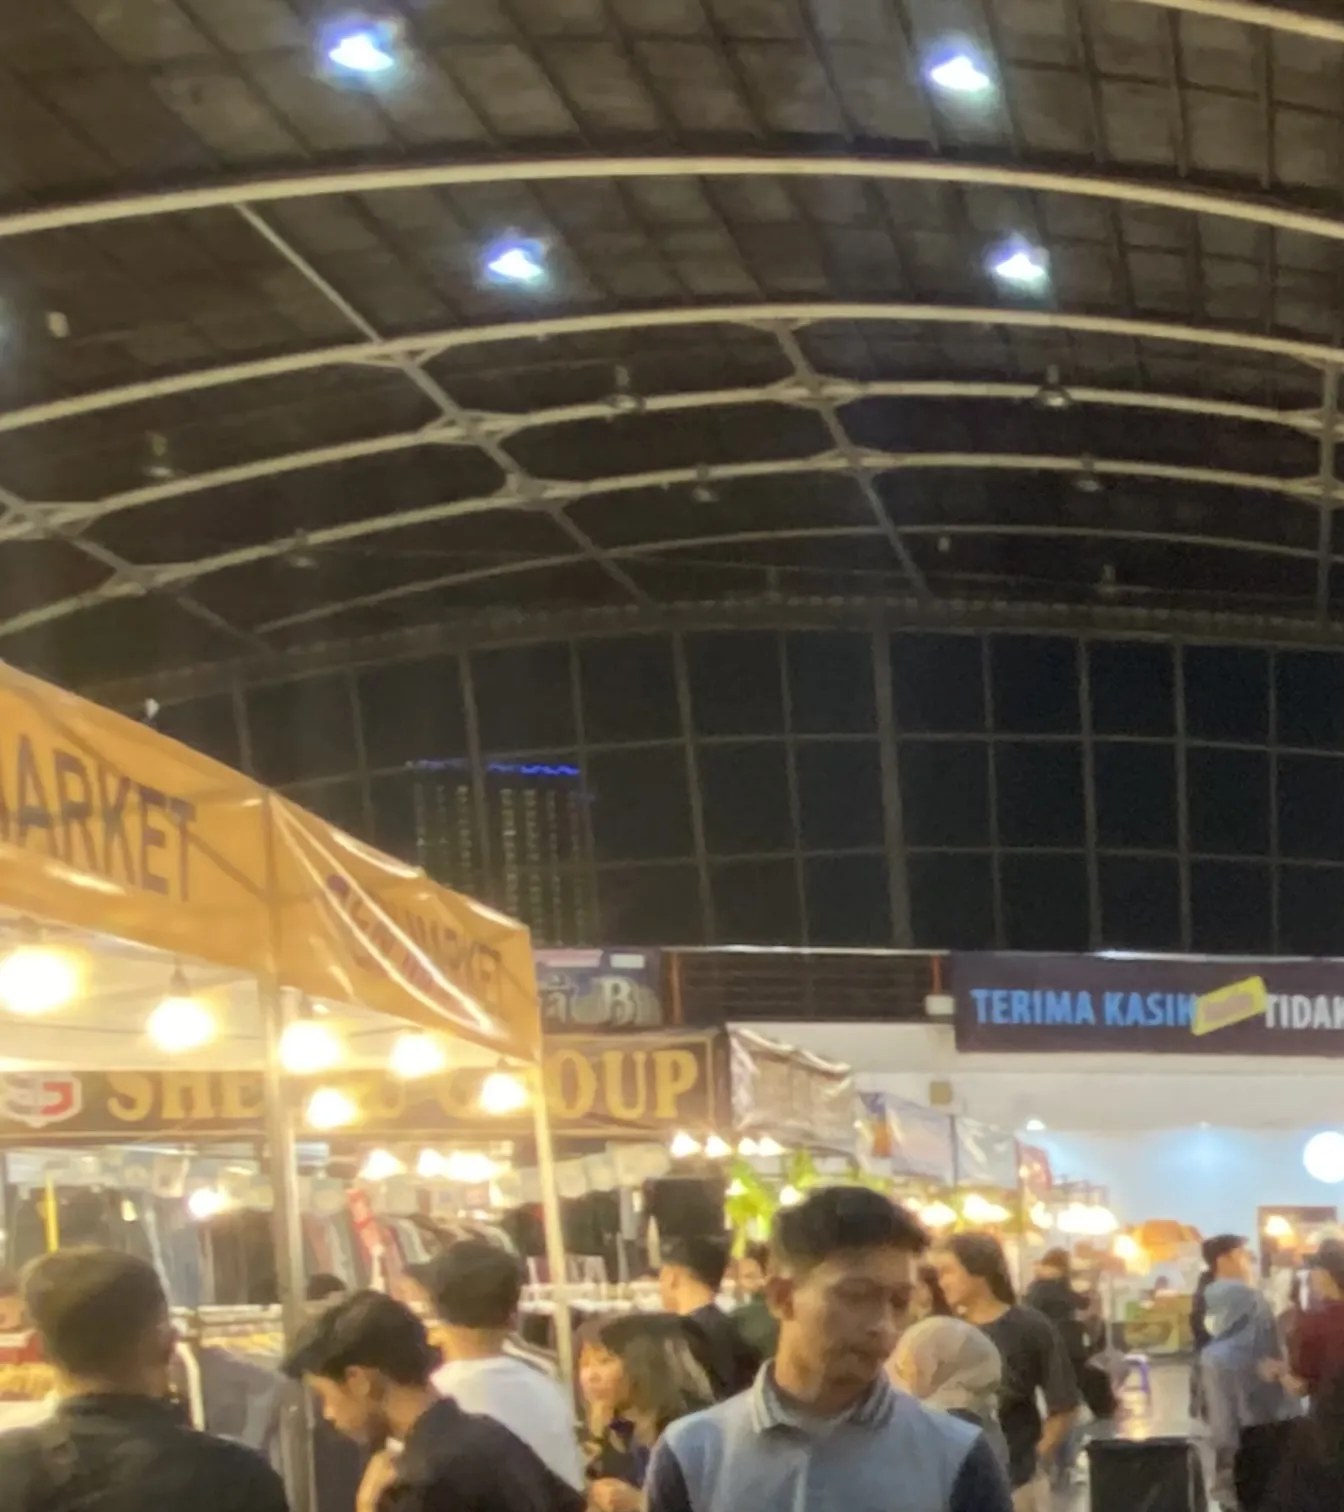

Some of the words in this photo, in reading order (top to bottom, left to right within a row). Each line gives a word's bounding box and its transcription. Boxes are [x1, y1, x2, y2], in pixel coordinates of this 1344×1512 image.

[0, 733, 197, 902] ARKET
[969, 988, 1097, 1025] TERIMA
[1104, 991, 1198, 1027] KASIH
